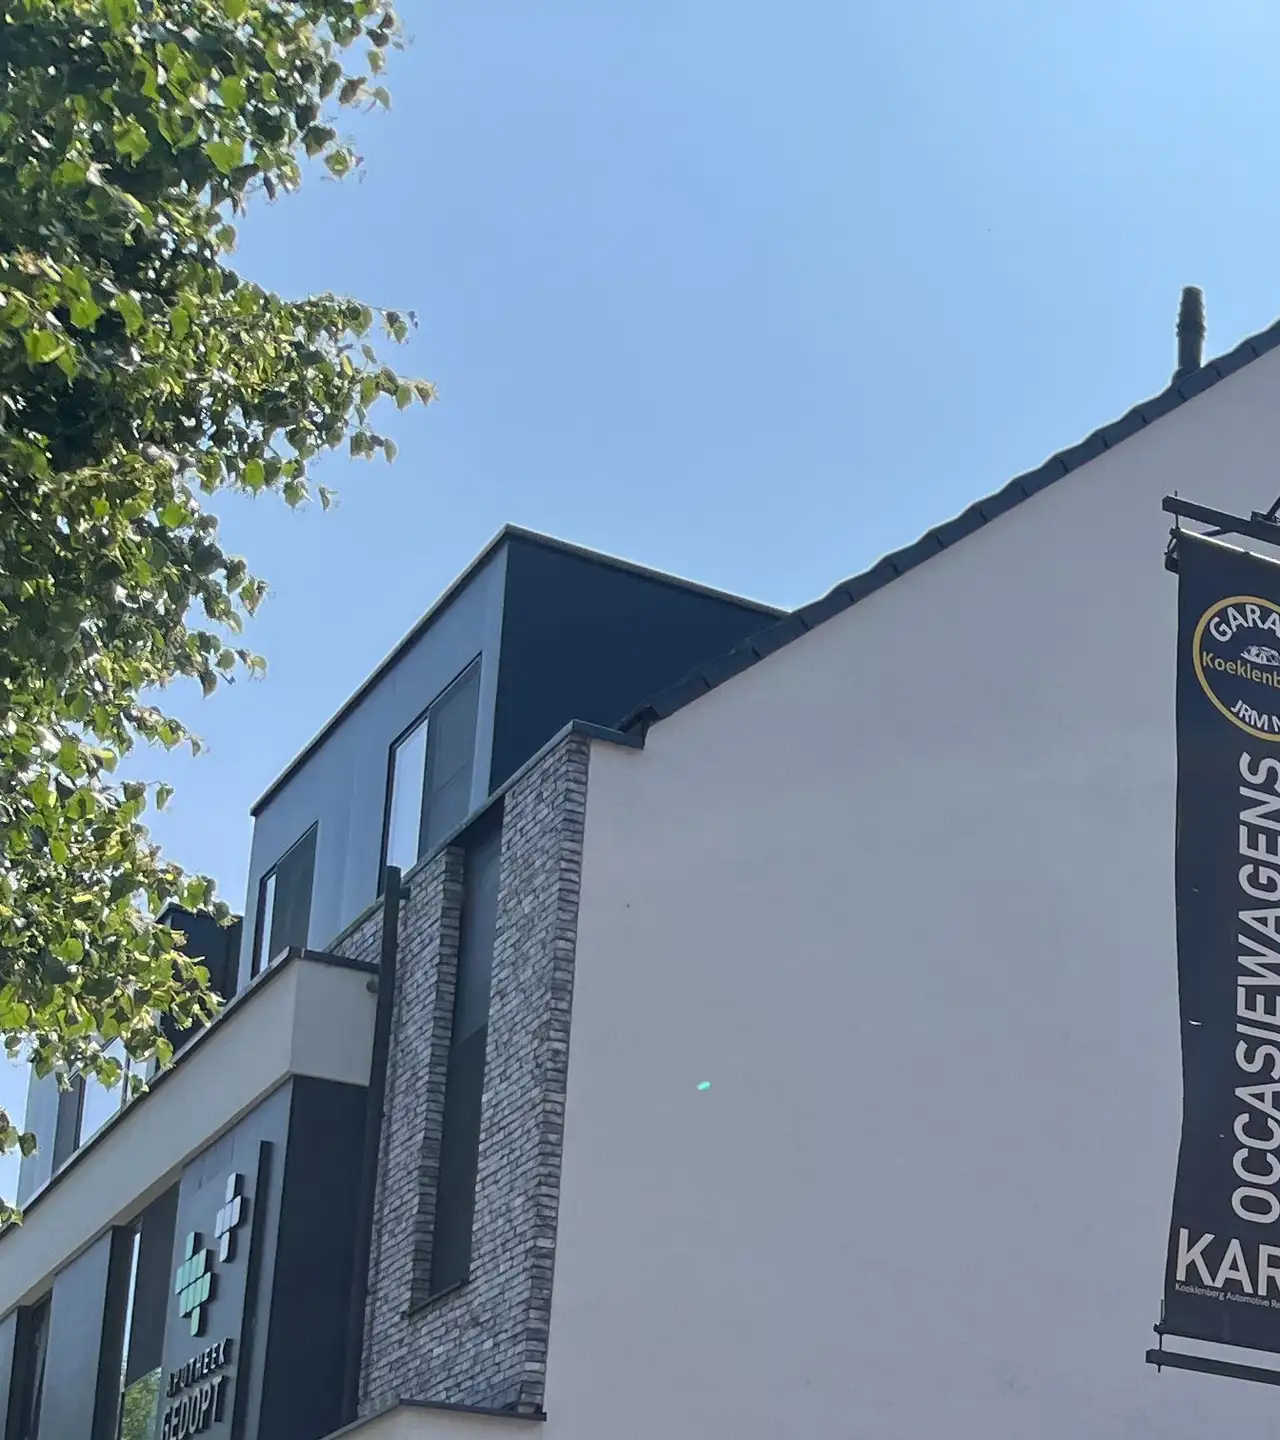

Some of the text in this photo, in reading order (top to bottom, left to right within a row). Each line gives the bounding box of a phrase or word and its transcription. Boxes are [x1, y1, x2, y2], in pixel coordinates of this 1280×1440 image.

[1230, 699, 1269, 731] JRM
[1174, 1282, 1225, 1301] Koeklenberg
[1225, 1291, 1270, 1307] Automotive
